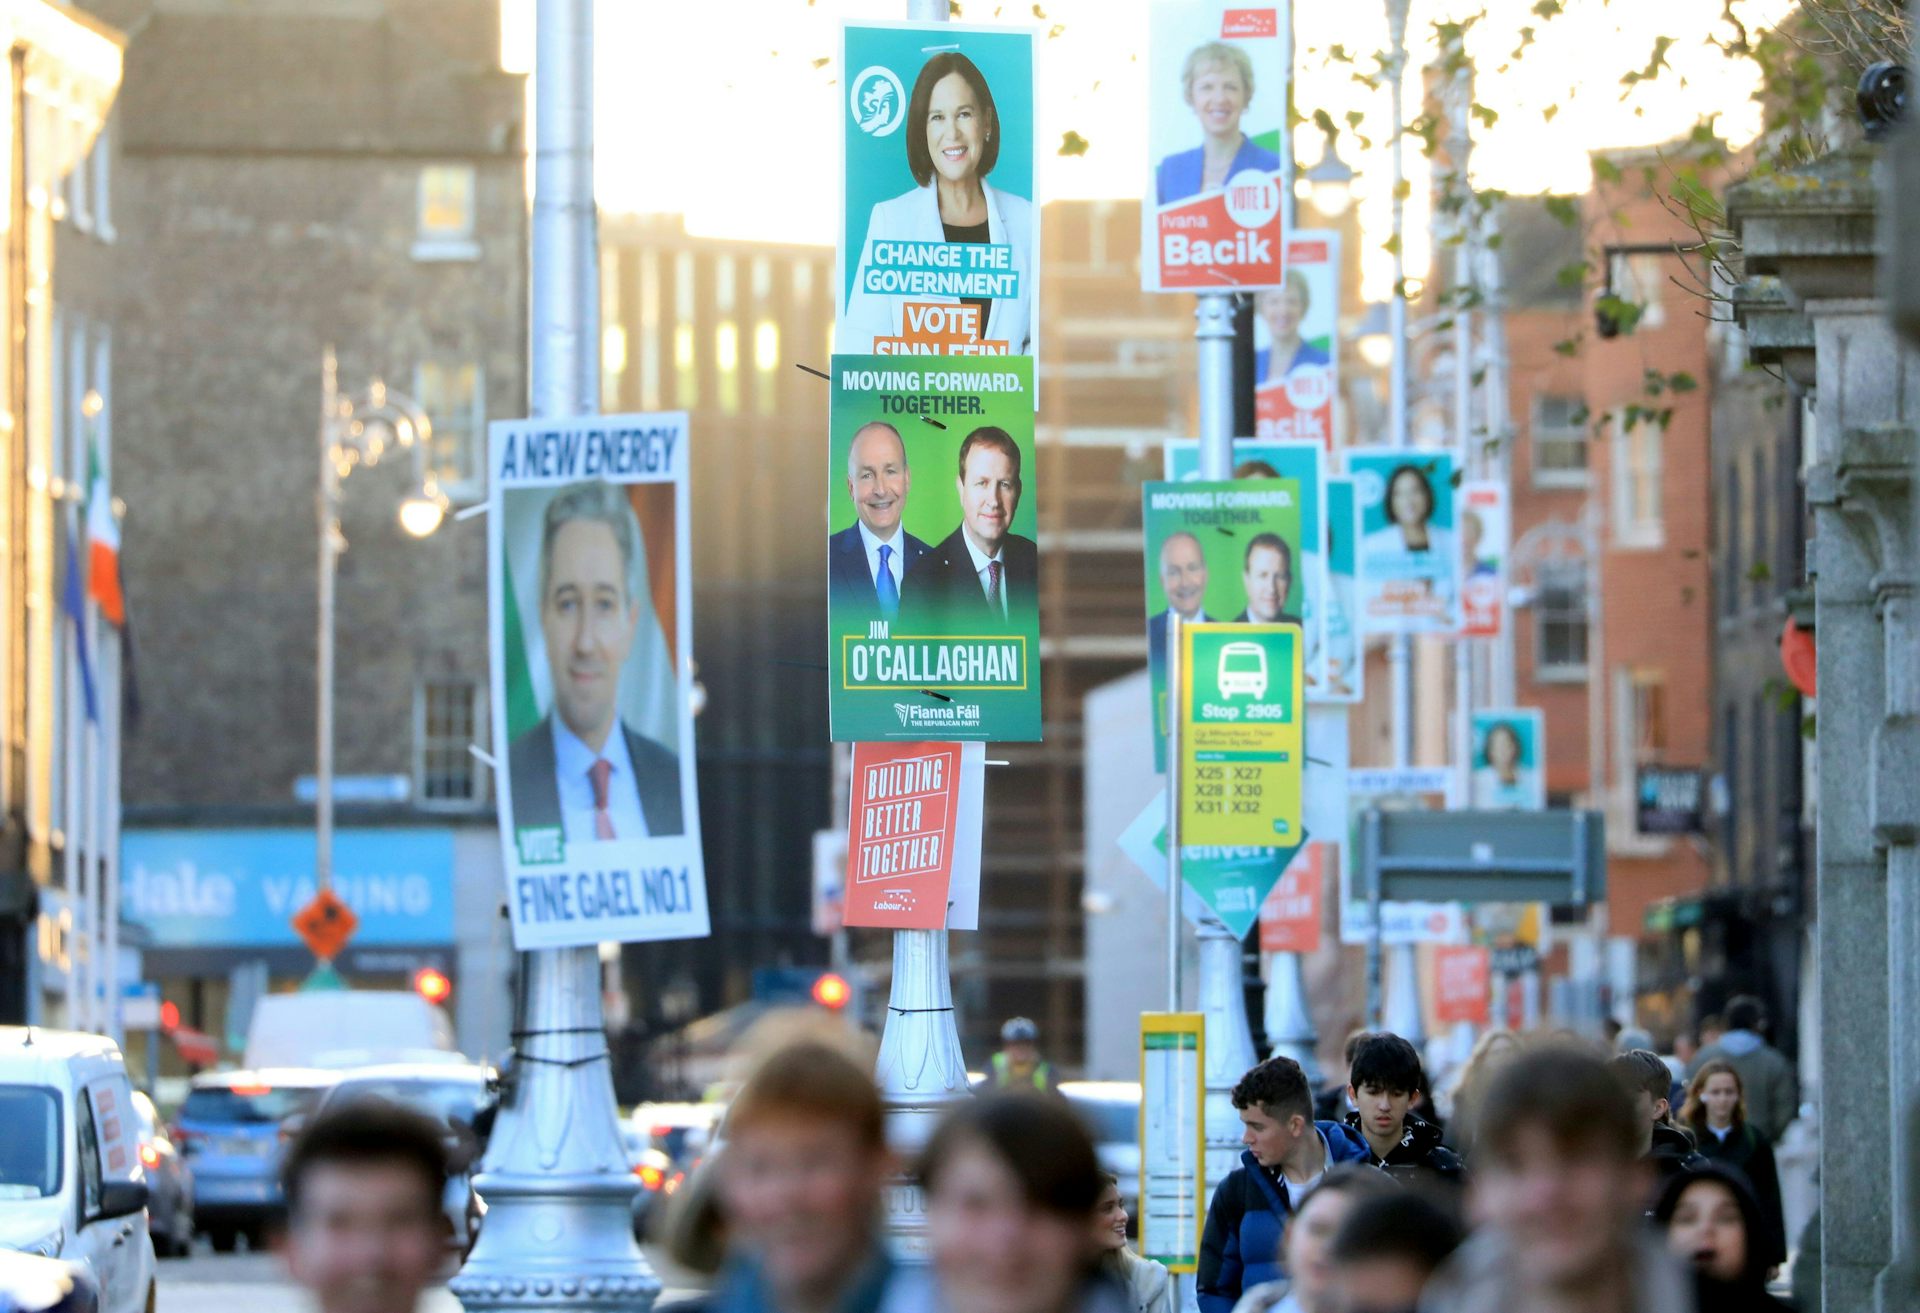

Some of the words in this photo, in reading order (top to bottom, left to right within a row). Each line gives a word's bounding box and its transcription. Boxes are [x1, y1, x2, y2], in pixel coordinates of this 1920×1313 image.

[1232, 186, 1259, 210] VOTE
[1263, 186, 1271, 210] 1
[1162, 214, 1208, 229] Ivana
[874, 243, 962, 268] CHANGE
[966, 246, 1009, 269] THE
[1163, 230, 1272, 267] Bacik
[865, 269, 1017, 296] GOVERNMENT
[906, 306, 978, 334] VOTE
[842, 371, 920, 391] MOVING
[924, 372, 1024, 392] FORWARD.
[879, 395, 986, 415] TOGETHER.
[500, 431, 518, 478] A
[523, 430, 582, 477] NEW
[585, 427, 679, 475] ENERGY
[1151, 492, 1214, 510] MOVING
[1215, 490, 1293, 508] FORWARD.
[868, 621, 889, 640] JIM
[852, 644, 1018, 682] O'CALLAGHAN
[909, 704, 954, 720] Fianna
[956, 704, 980, 720] Fáil
[1201, 702, 1240, 721] Stop
[1245, 703, 1283, 719] 2905
[911, 719, 923, 727] THE
[924, 719, 960, 727] REPUBLICAN
[961, 719, 980, 727] PARTY
[868, 758, 943, 801] BUILDING
[1195, 766, 1224, 780] X25
[1234, 766, 1262, 780] X27
[1195, 783, 1224, 797] X28
[1234, 783, 1263, 797] X30
[1195, 800, 1223, 815] X31
[1232, 800, 1260, 815] X32
[865, 800, 922, 839] BETTER
[520, 828, 563, 863] VOTE
[863, 836, 940, 877] TOGETHER
[518, 875, 575, 923] FINE
[577, 869, 639, 919] GAEL
[642, 866, 692, 915] NO.1
[874, 901, 902, 911] Labour
